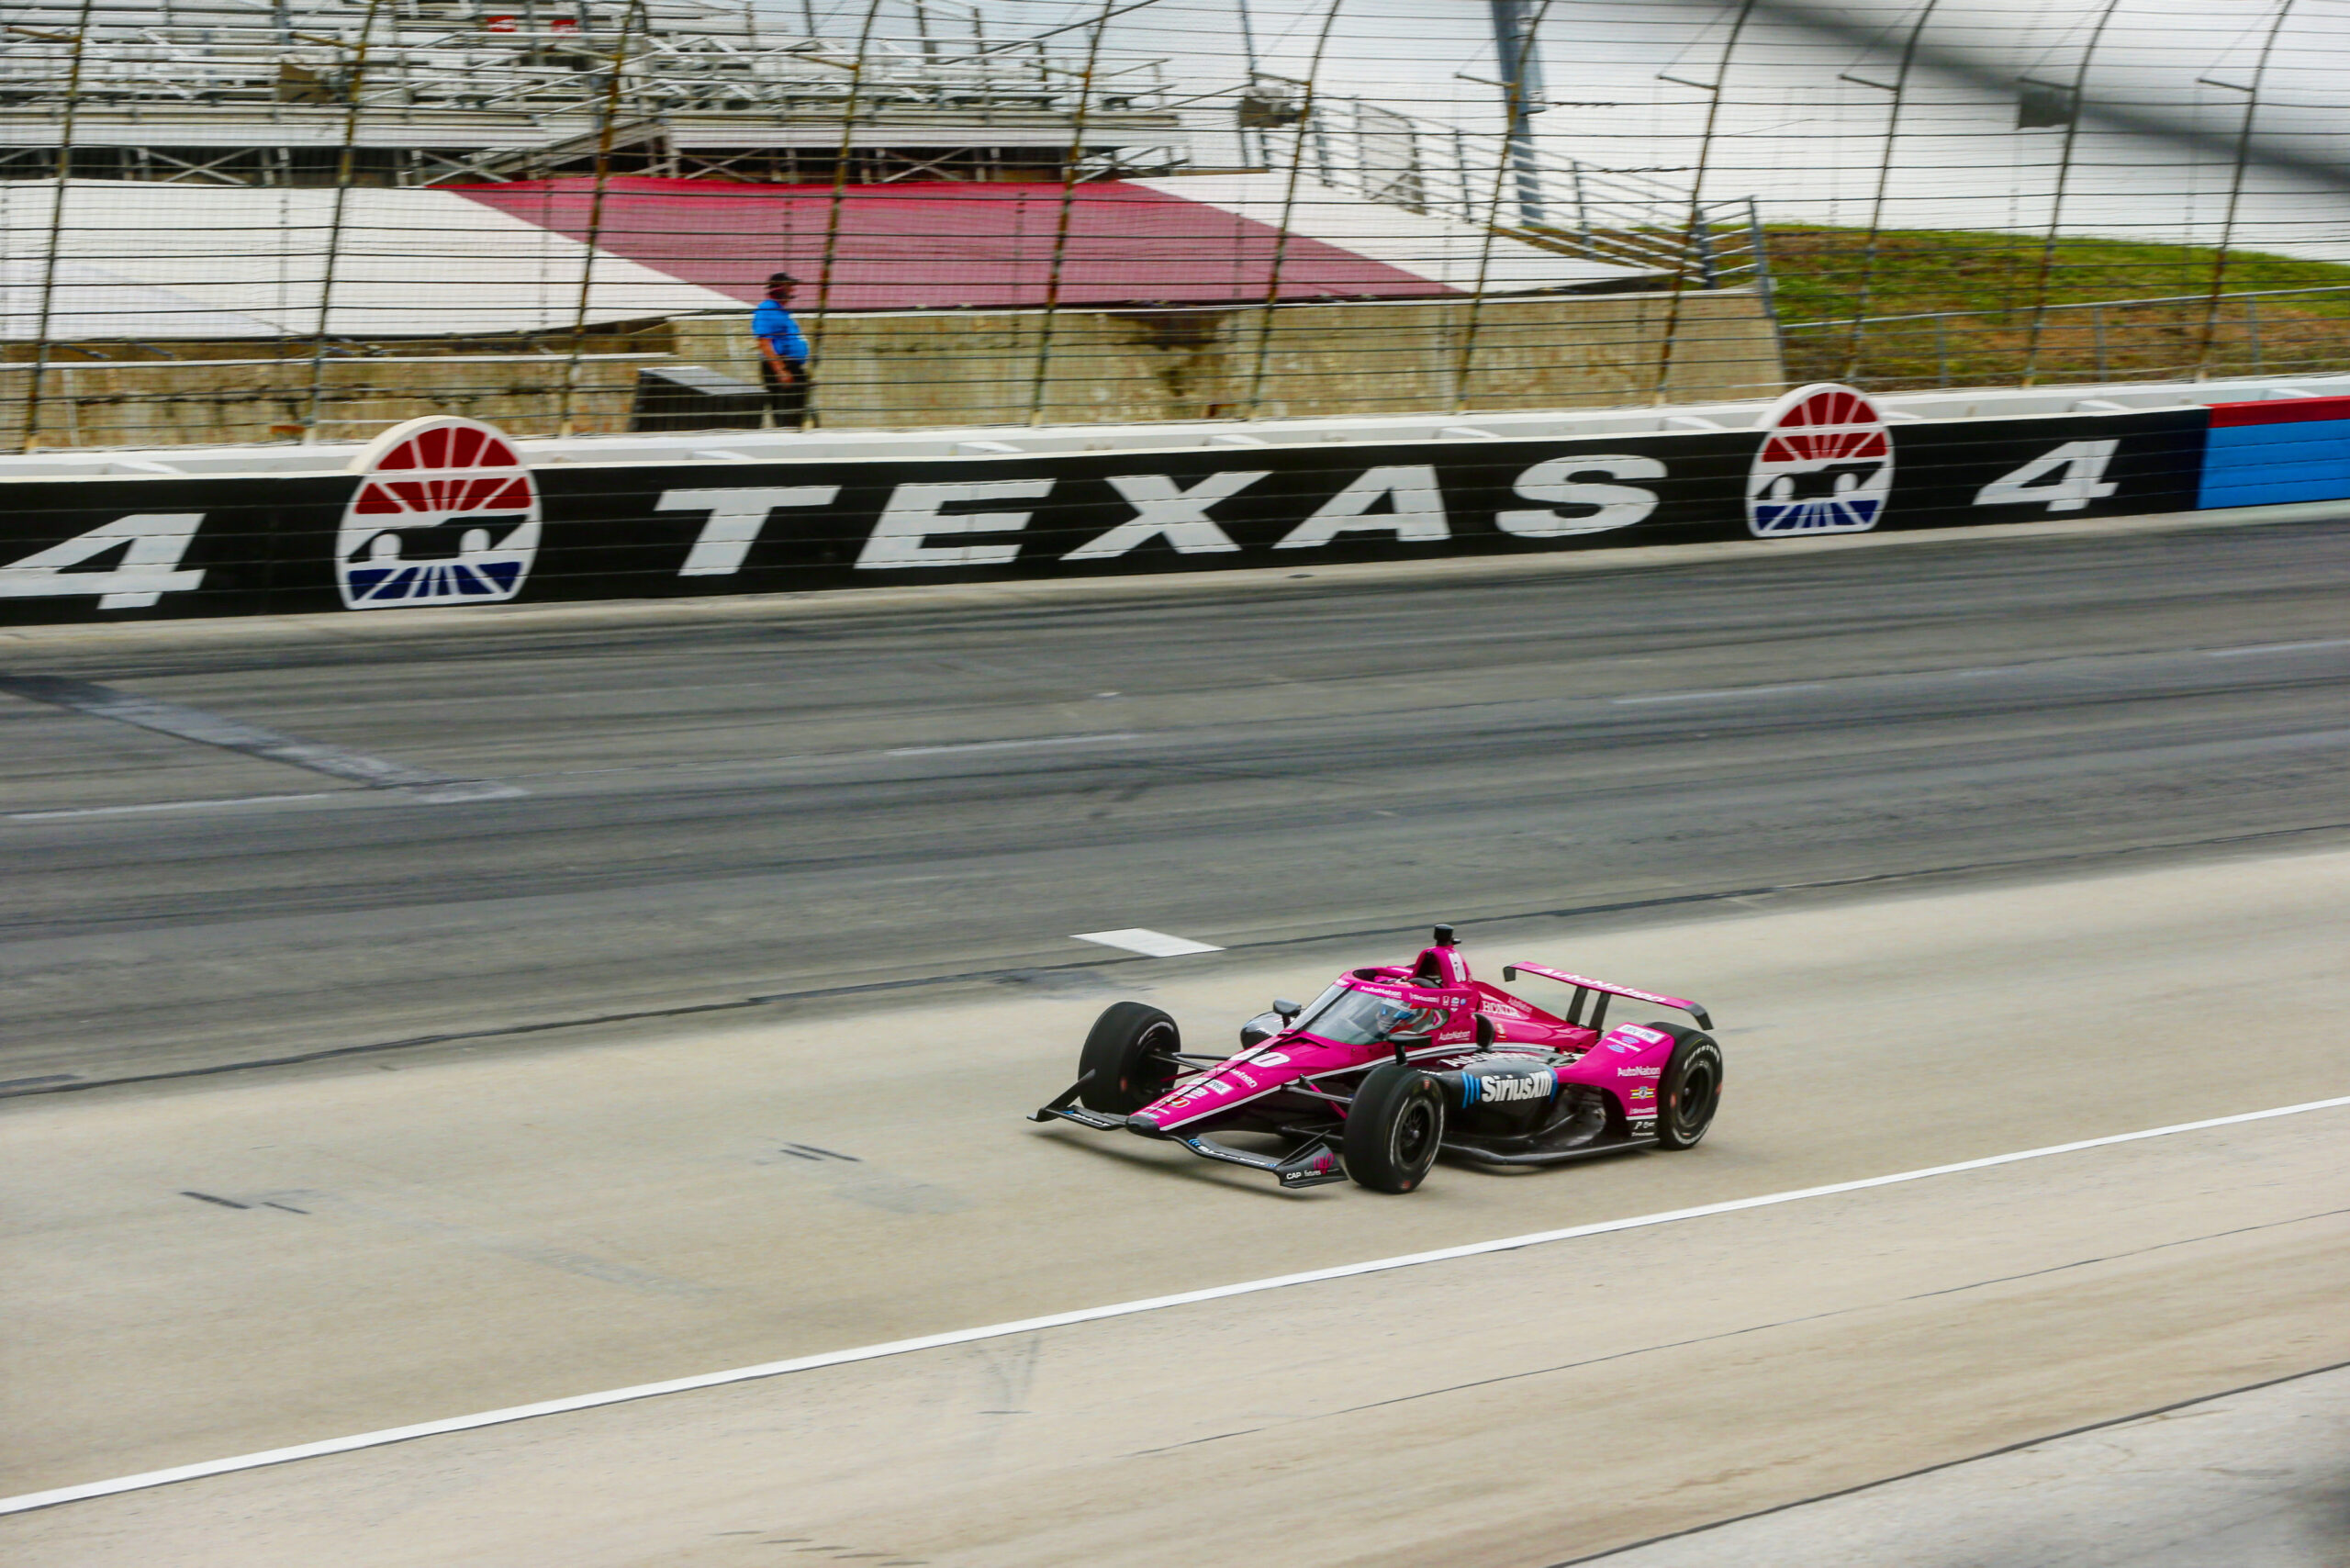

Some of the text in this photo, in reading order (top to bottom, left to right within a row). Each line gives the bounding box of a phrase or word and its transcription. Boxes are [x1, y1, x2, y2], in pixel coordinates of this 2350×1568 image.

[1972, 440, 2120, 512] 4
[655, 454, 1670, 577] TEXAS
[0, 512, 205, 610] 4
[1360, 985, 1402, 997] AutoNation
[1534, 968, 1666, 1002] AutoNation
[1438, 1031, 1471, 1041] AutoNation
[1617, 1066, 1660, 1078] AutoNation
[1286, 1171, 1302, 1180] CAP
